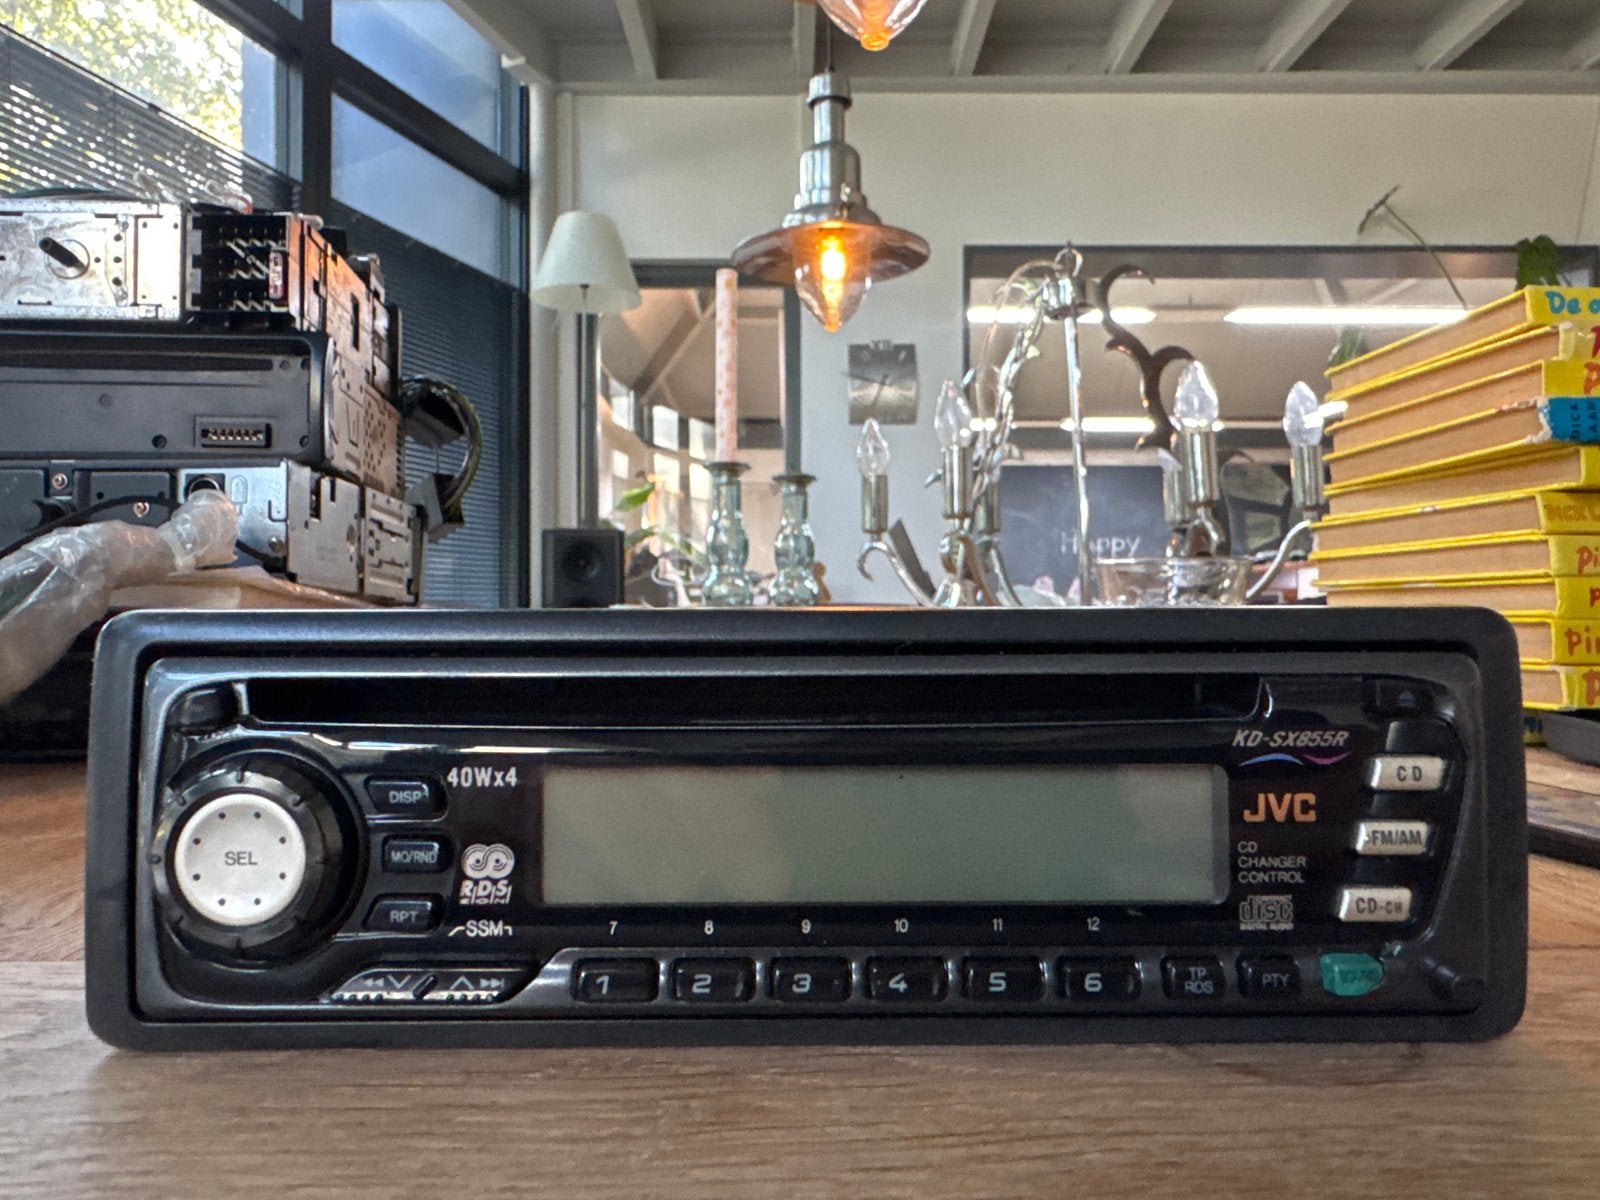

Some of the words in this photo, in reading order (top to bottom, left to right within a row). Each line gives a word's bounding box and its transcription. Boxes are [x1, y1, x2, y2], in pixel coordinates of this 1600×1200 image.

[1545, 290, 1580, 315] De
[1232, 729, 1350, 747] KD-SX855R
[446, 766, 518, 788] 40Wx4
[1396, 765, 1422, 782] CD
[388, 791, 422, 804] DISP
[1243, 792, 1317, 823] JVC
[1371, 830, 1423, 846] FM/AM
[1237, 841, 1258, 853] CD
[224, 850, 259, 866] SEL
[1237, 856, 1307, 868] CHANGER
[1237, 871, 1304, 883] CONTROL
[389, 910, 419, 923] RPT
[991, 918, 1003, 931] 11
[1086, 917, 1100, 931] 12
[466, 919, 504, 937] SSM
[608, 920, 618, 935] 7
[703, 919, 715, 935] 8
[801, 919, 812, 934] 9
[893, 918, 909, 933] 10
[1187, 966, 1207, 980] TP
[1262, 973, 1289, 987] PTY
[595, 975, 610, 995] 1
[691, 973, 712, 993] 2
[791, 973, 812, 993] 3
[888, 973, 908, 993] 4
[988, 972, 1007, 992] 5
[1084, 972, 1102, 992] 6
[1184, 980, 1214, 994] RDS
